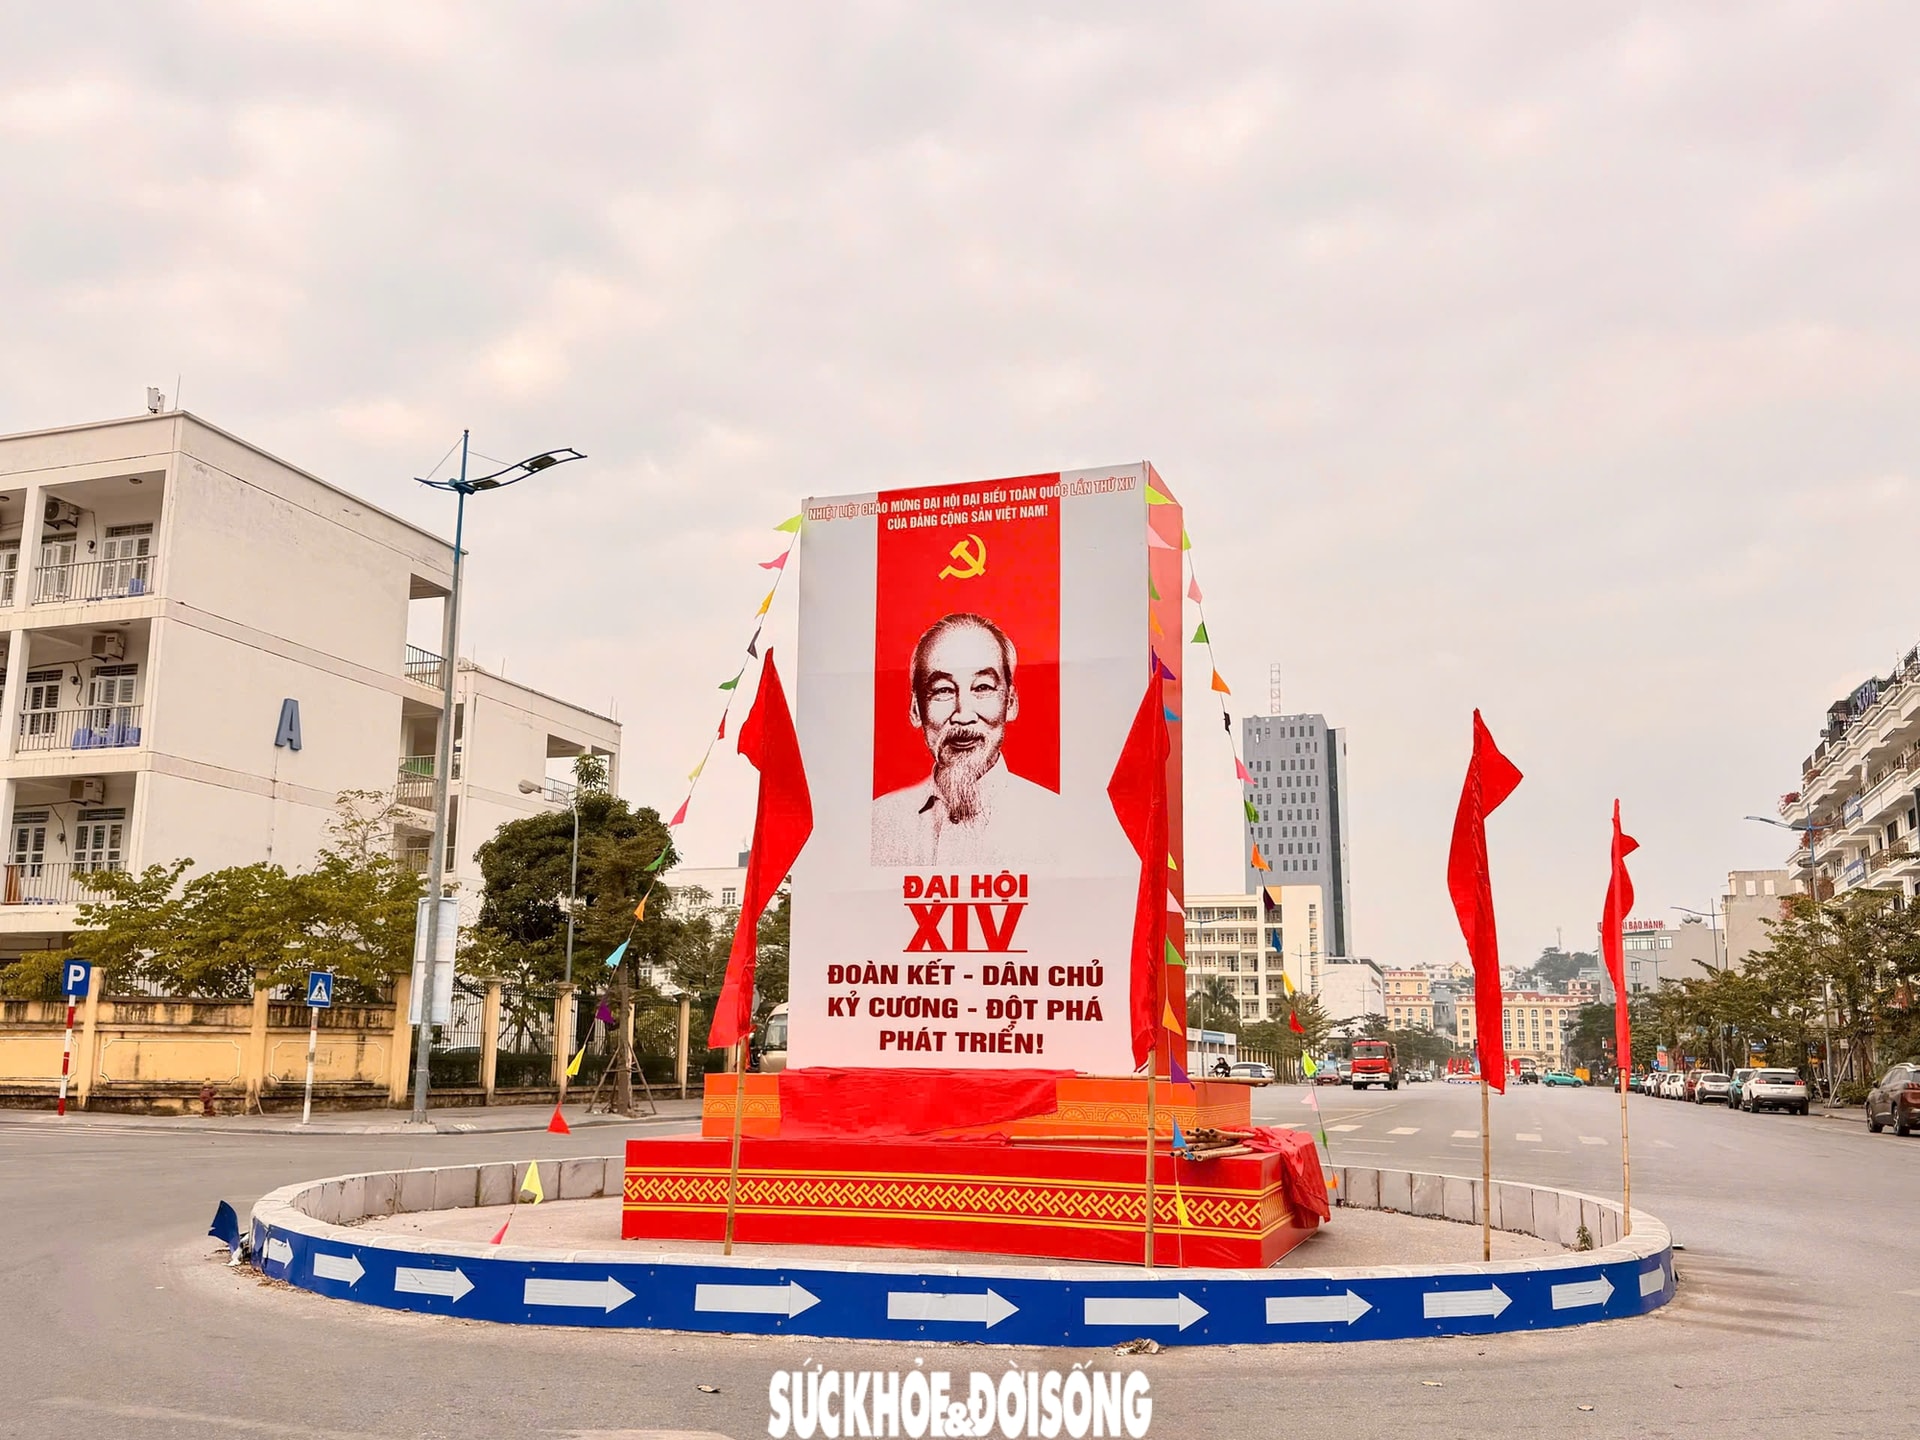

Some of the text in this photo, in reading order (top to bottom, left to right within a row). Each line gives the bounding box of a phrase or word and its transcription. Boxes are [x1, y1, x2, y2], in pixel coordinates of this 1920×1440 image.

[808, 476, 1137, 522] NHIỆT LIỆT CHÀO MỪNG ĐẠI HỘI ĐẠI BIỂU TOÀN QUỐC LẦN THỨ XIV
[887, 503, 1049, 531] CỦA ĐẢNG CỘNG SẢN VIỆT NAM!
[274, 697, 303, 752] A
[903, 870, 1028, 903] ĐẠI HỘI
[904, 903, 1028, 952] XIV
[67, 964, 86, 991] P
[827, 960, 899, 985] ĐOÀN
[907, 958, 956, 986] KẾT
[982, 961, 1039, 987] DÂN
[1048, 959, 1104, 987] CHỦ
[828, 990, 861, 1018] KỶ
[868, 996, 958, 1019] CƯƠNG
[986, 994, 1038, 1024] ĐỘT
[1047, 996, 1104, 1022] PHÁ
[879, 1023, 1044, 1054] PHÁT TRIỂN!
